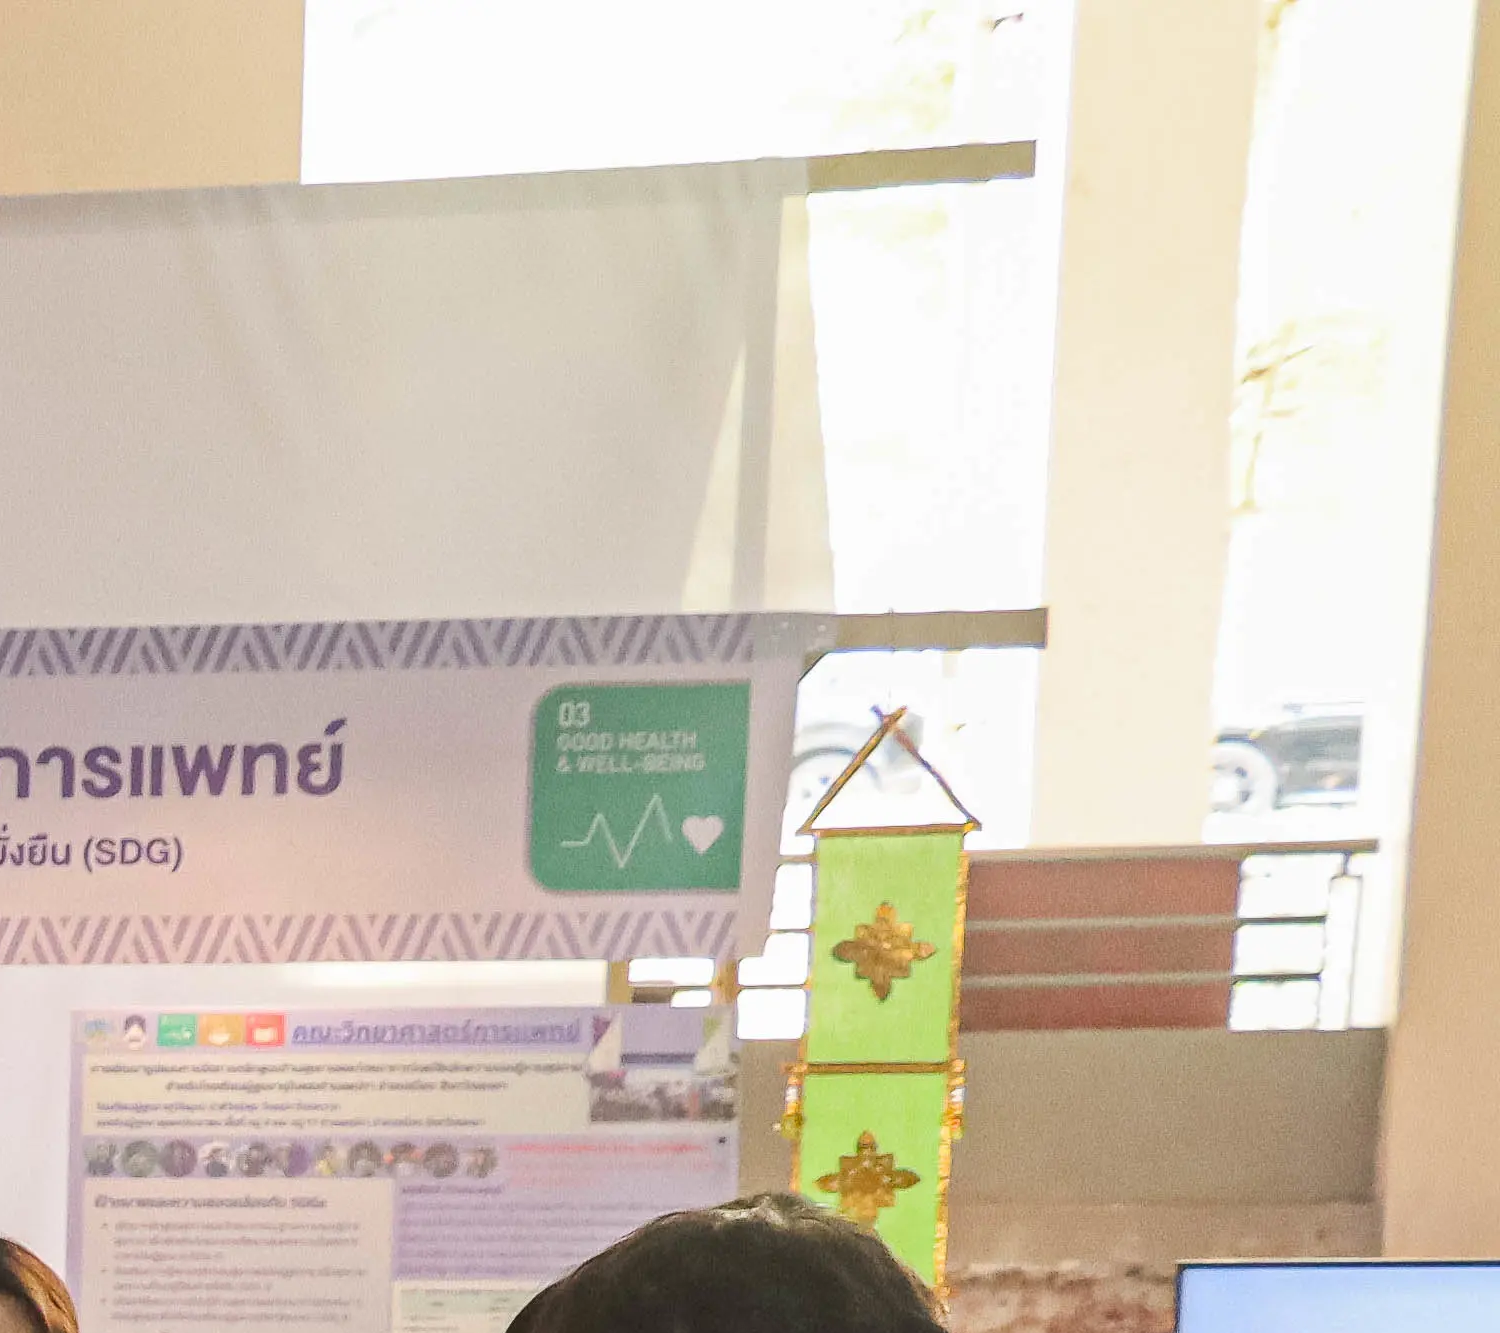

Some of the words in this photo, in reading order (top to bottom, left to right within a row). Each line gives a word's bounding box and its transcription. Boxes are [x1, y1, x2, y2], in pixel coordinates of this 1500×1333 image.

[558, 701, 591, 728] 03
[557, 733, 614, 751] GOOD
[619, 731, 697, 750] HEALTH
[83, 835, 184, 874] (SDG)
